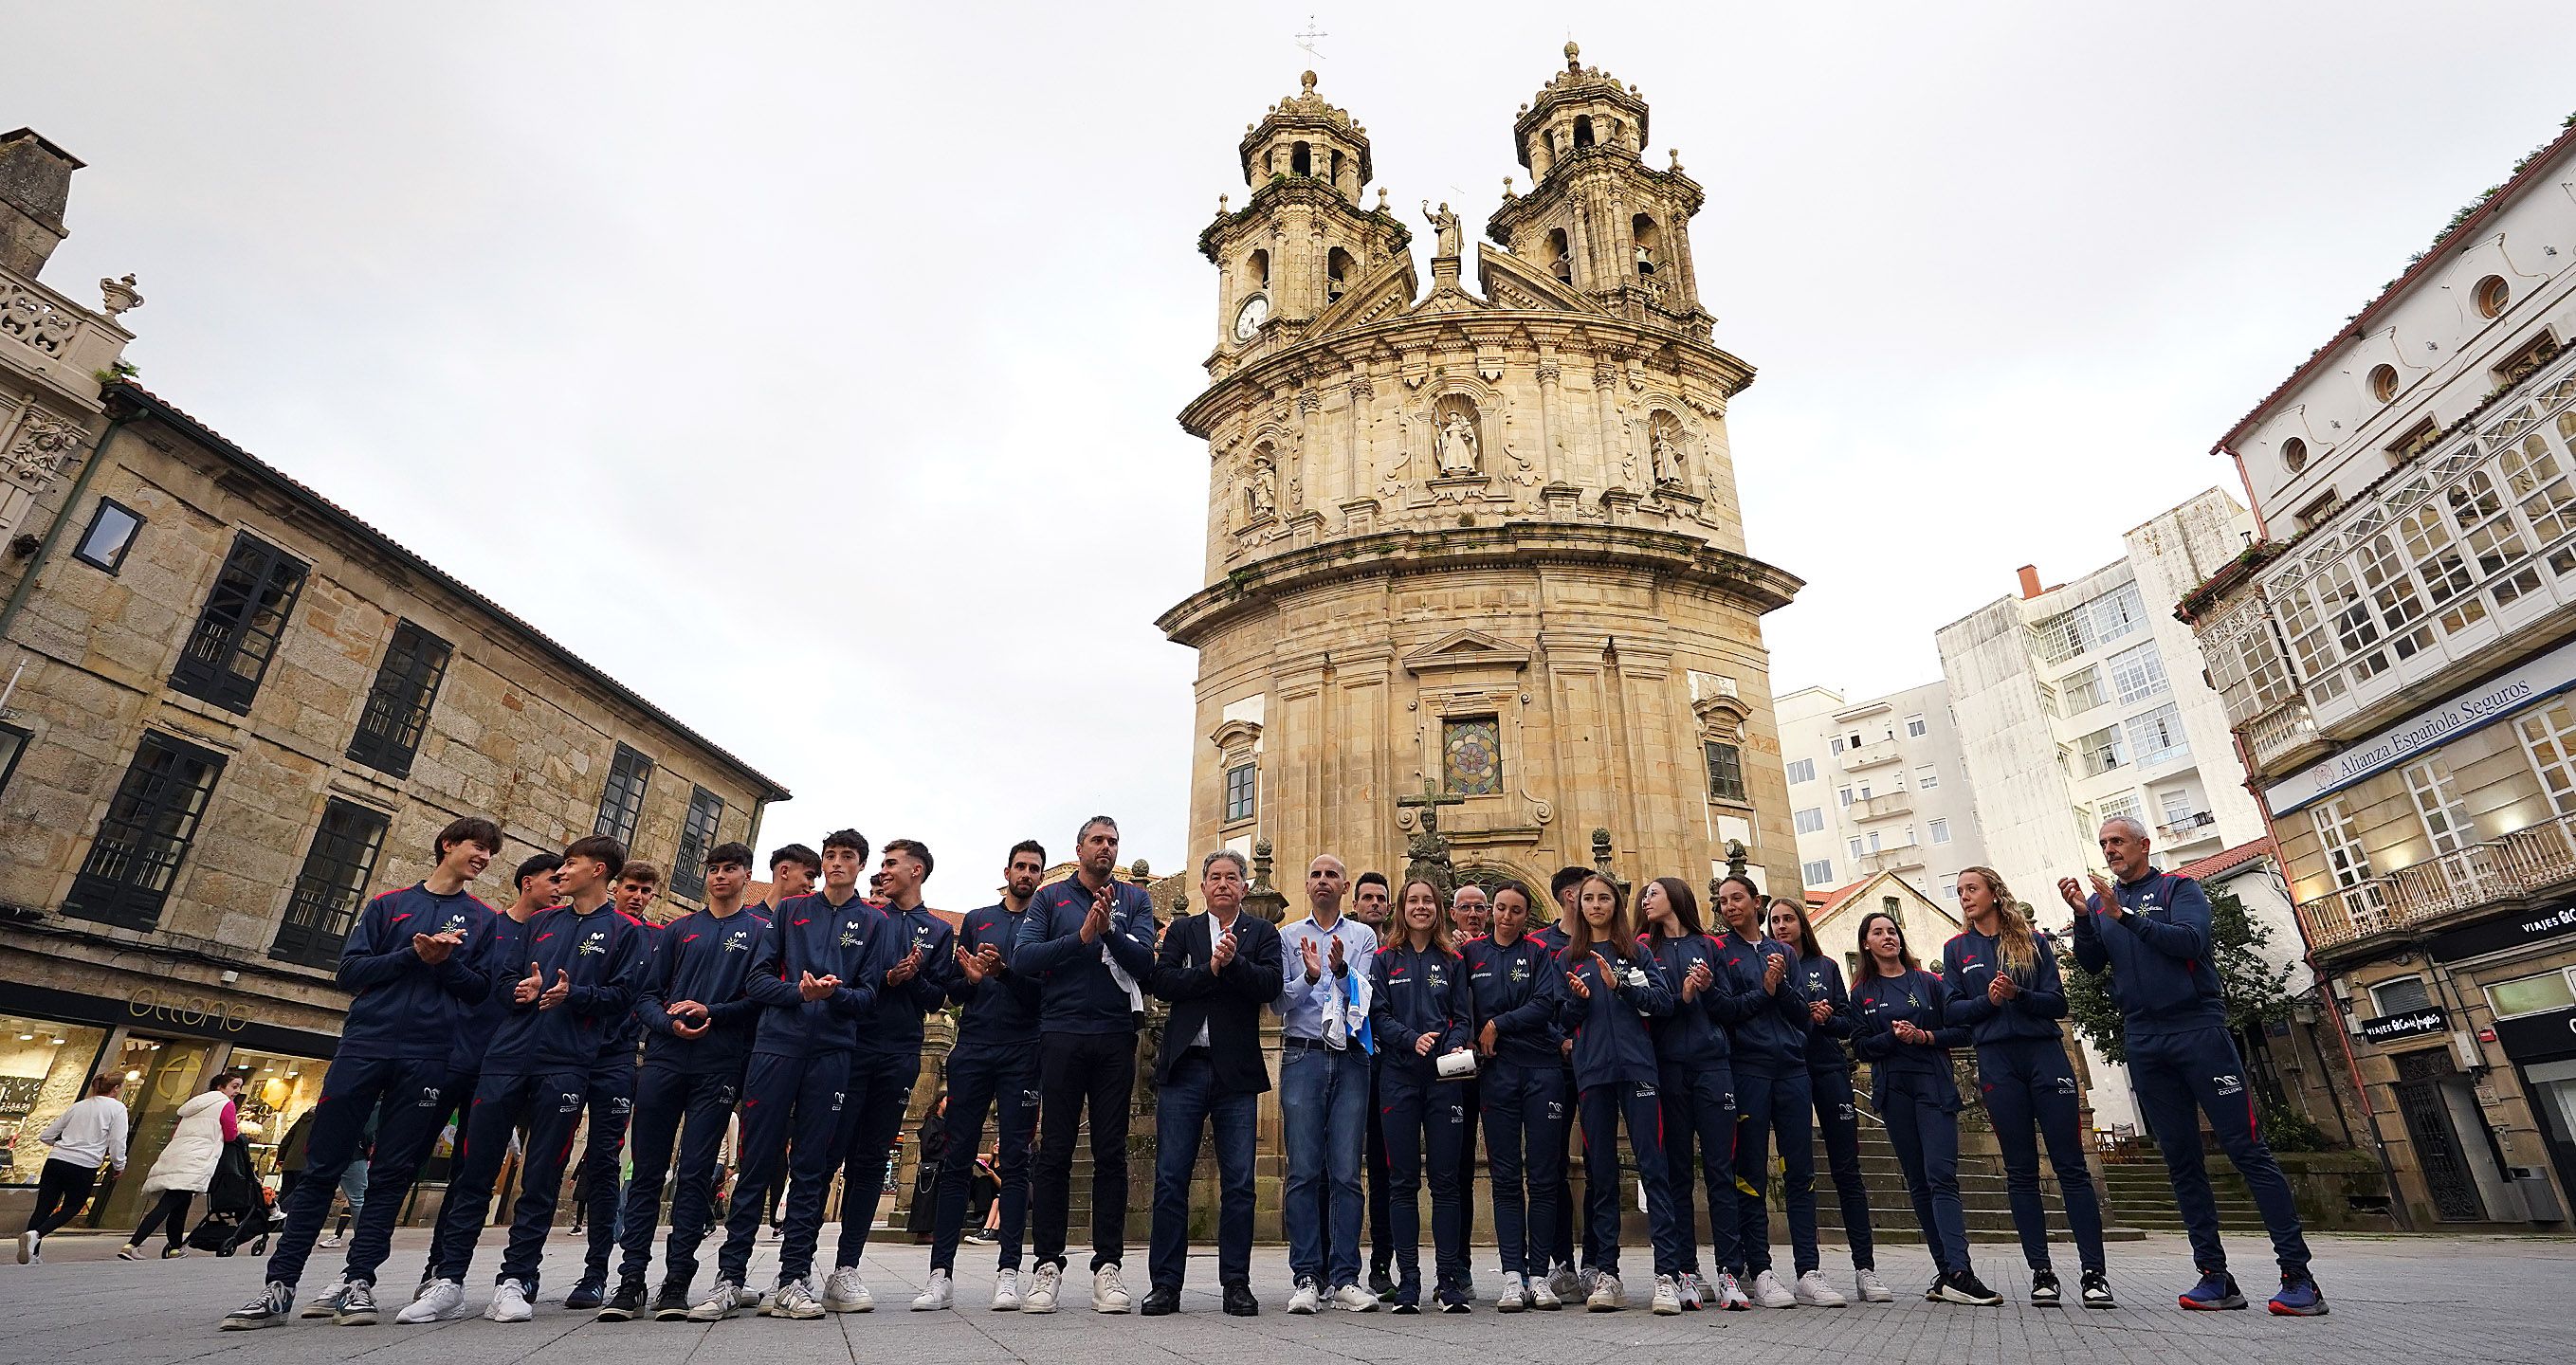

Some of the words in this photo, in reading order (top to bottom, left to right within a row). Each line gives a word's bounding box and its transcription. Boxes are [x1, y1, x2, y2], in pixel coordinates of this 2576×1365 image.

[2340, 744, 2391, 777] Alianza
[2391, 711, 2460, 752] Española
[2460, 680, 2530, 719] Seguros
[2522, 917, 2559, 932] VIAJES
[2366, 1025, 2392, 1035] VIAJES
[2219, 1086, 2242, 1096] CICLISMO
